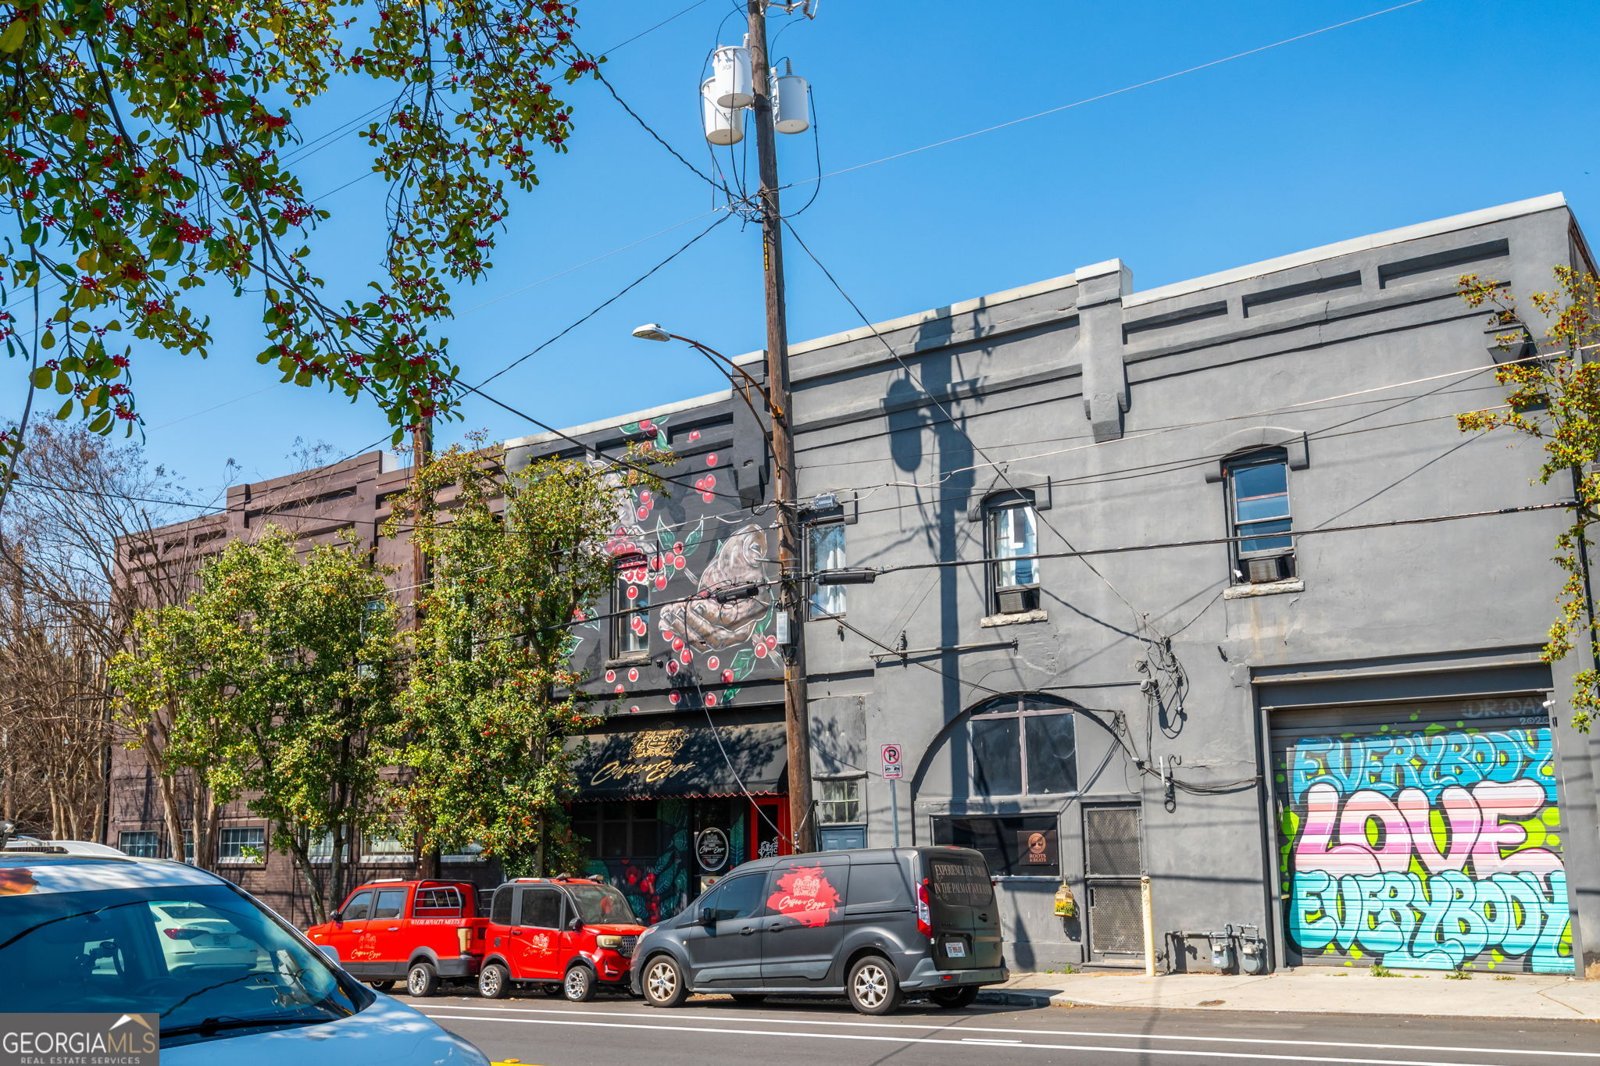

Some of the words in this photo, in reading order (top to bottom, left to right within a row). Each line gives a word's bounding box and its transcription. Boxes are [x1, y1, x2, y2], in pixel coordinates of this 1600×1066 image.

[1292, 727, 1557, 804] EVERYBODY
[1294, 779, 1565, 879] LOVE
[1290, 868, 1576, 973] EVERYBODY
